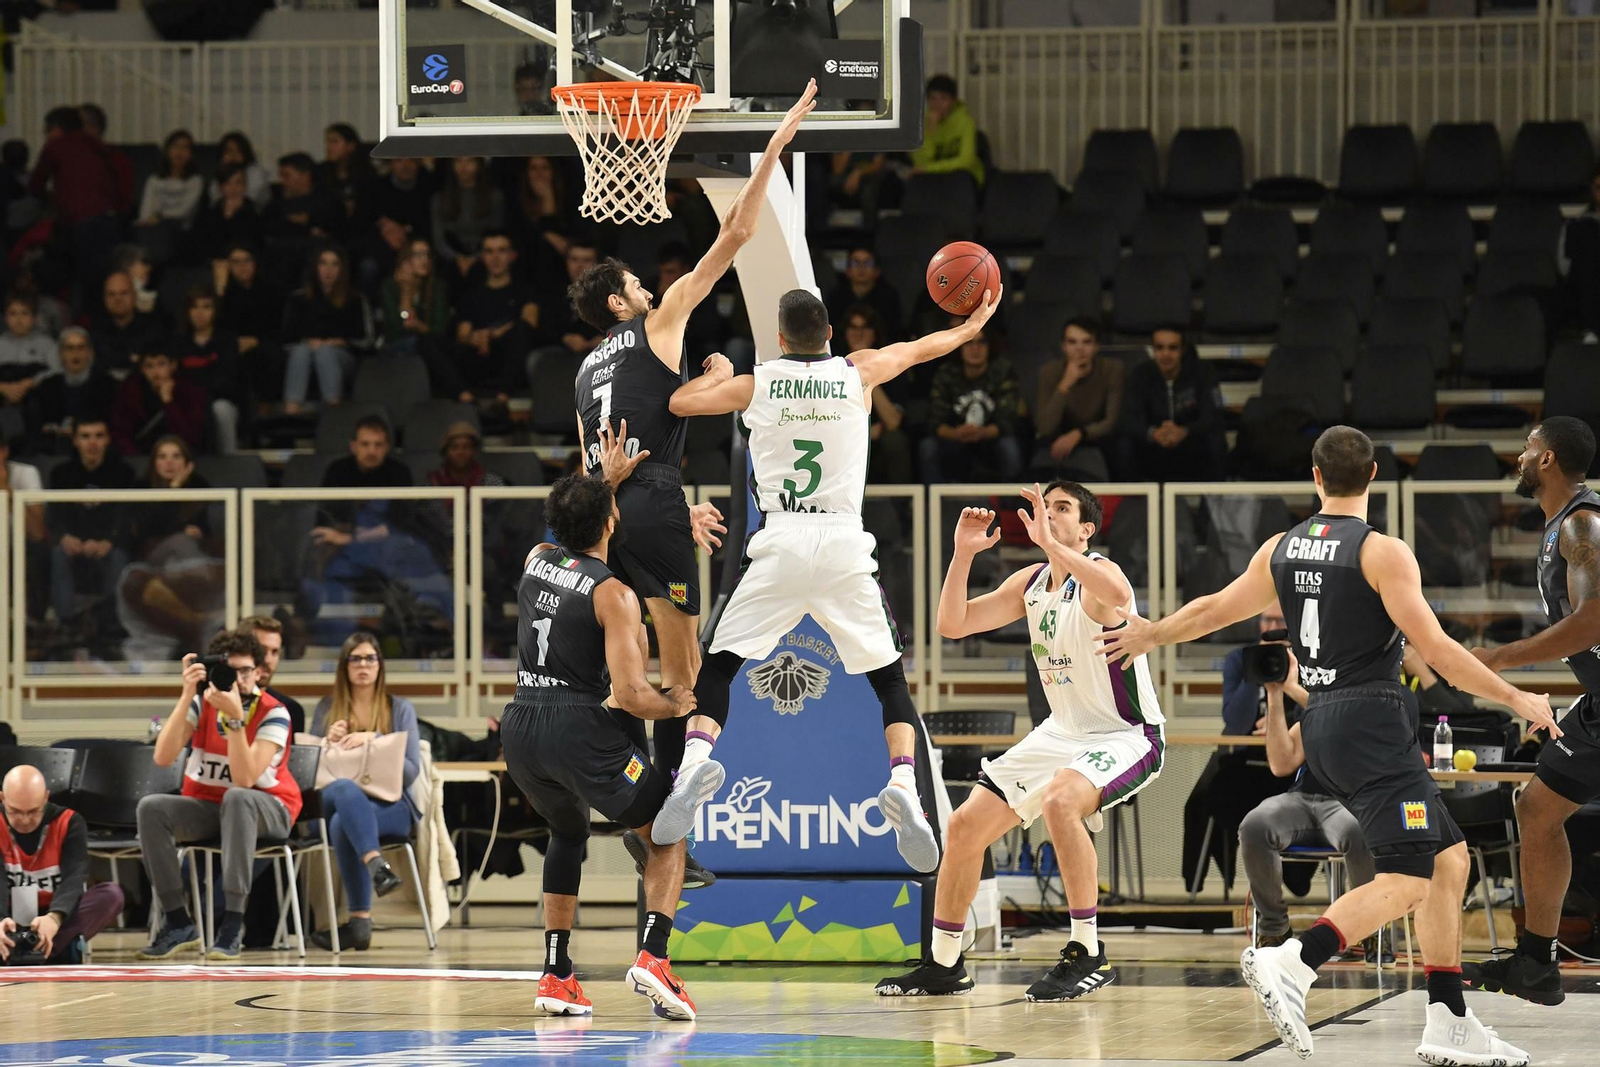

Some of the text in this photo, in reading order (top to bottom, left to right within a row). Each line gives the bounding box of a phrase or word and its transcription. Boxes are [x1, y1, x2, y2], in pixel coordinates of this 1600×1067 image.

[839, 65, 878, 73] oneteam
[411, 84, 450, 94] EuroCup
[591, 362, 616, 381] ITAS
[769, 375, 848, 400] FERNÁNDEZ
[592, 382, 612, 432] 7
[783, 439, 824, 499] 3
[1286, 537, 1341, 561] CRAFT
[576, 573, 596, 596] JR
[1294, 571, 1323, 586] ITAS
[1295, 585, 1321, 594] MUTUA
[534, 602, 557, 616] MUTUA
[536, 590, 561, 608] ITAS
[1038, 609, 1057, 641] 43
[1299, 598, 1321, 659] 4
[531, 617, 552, 667] 1
[786, 632, 841, 666] BASKET
[1087, 751, 1117, 773] 43
[694, 794, 893, 850] TRENTINO
[1407, 809, 1425, 820] MD
